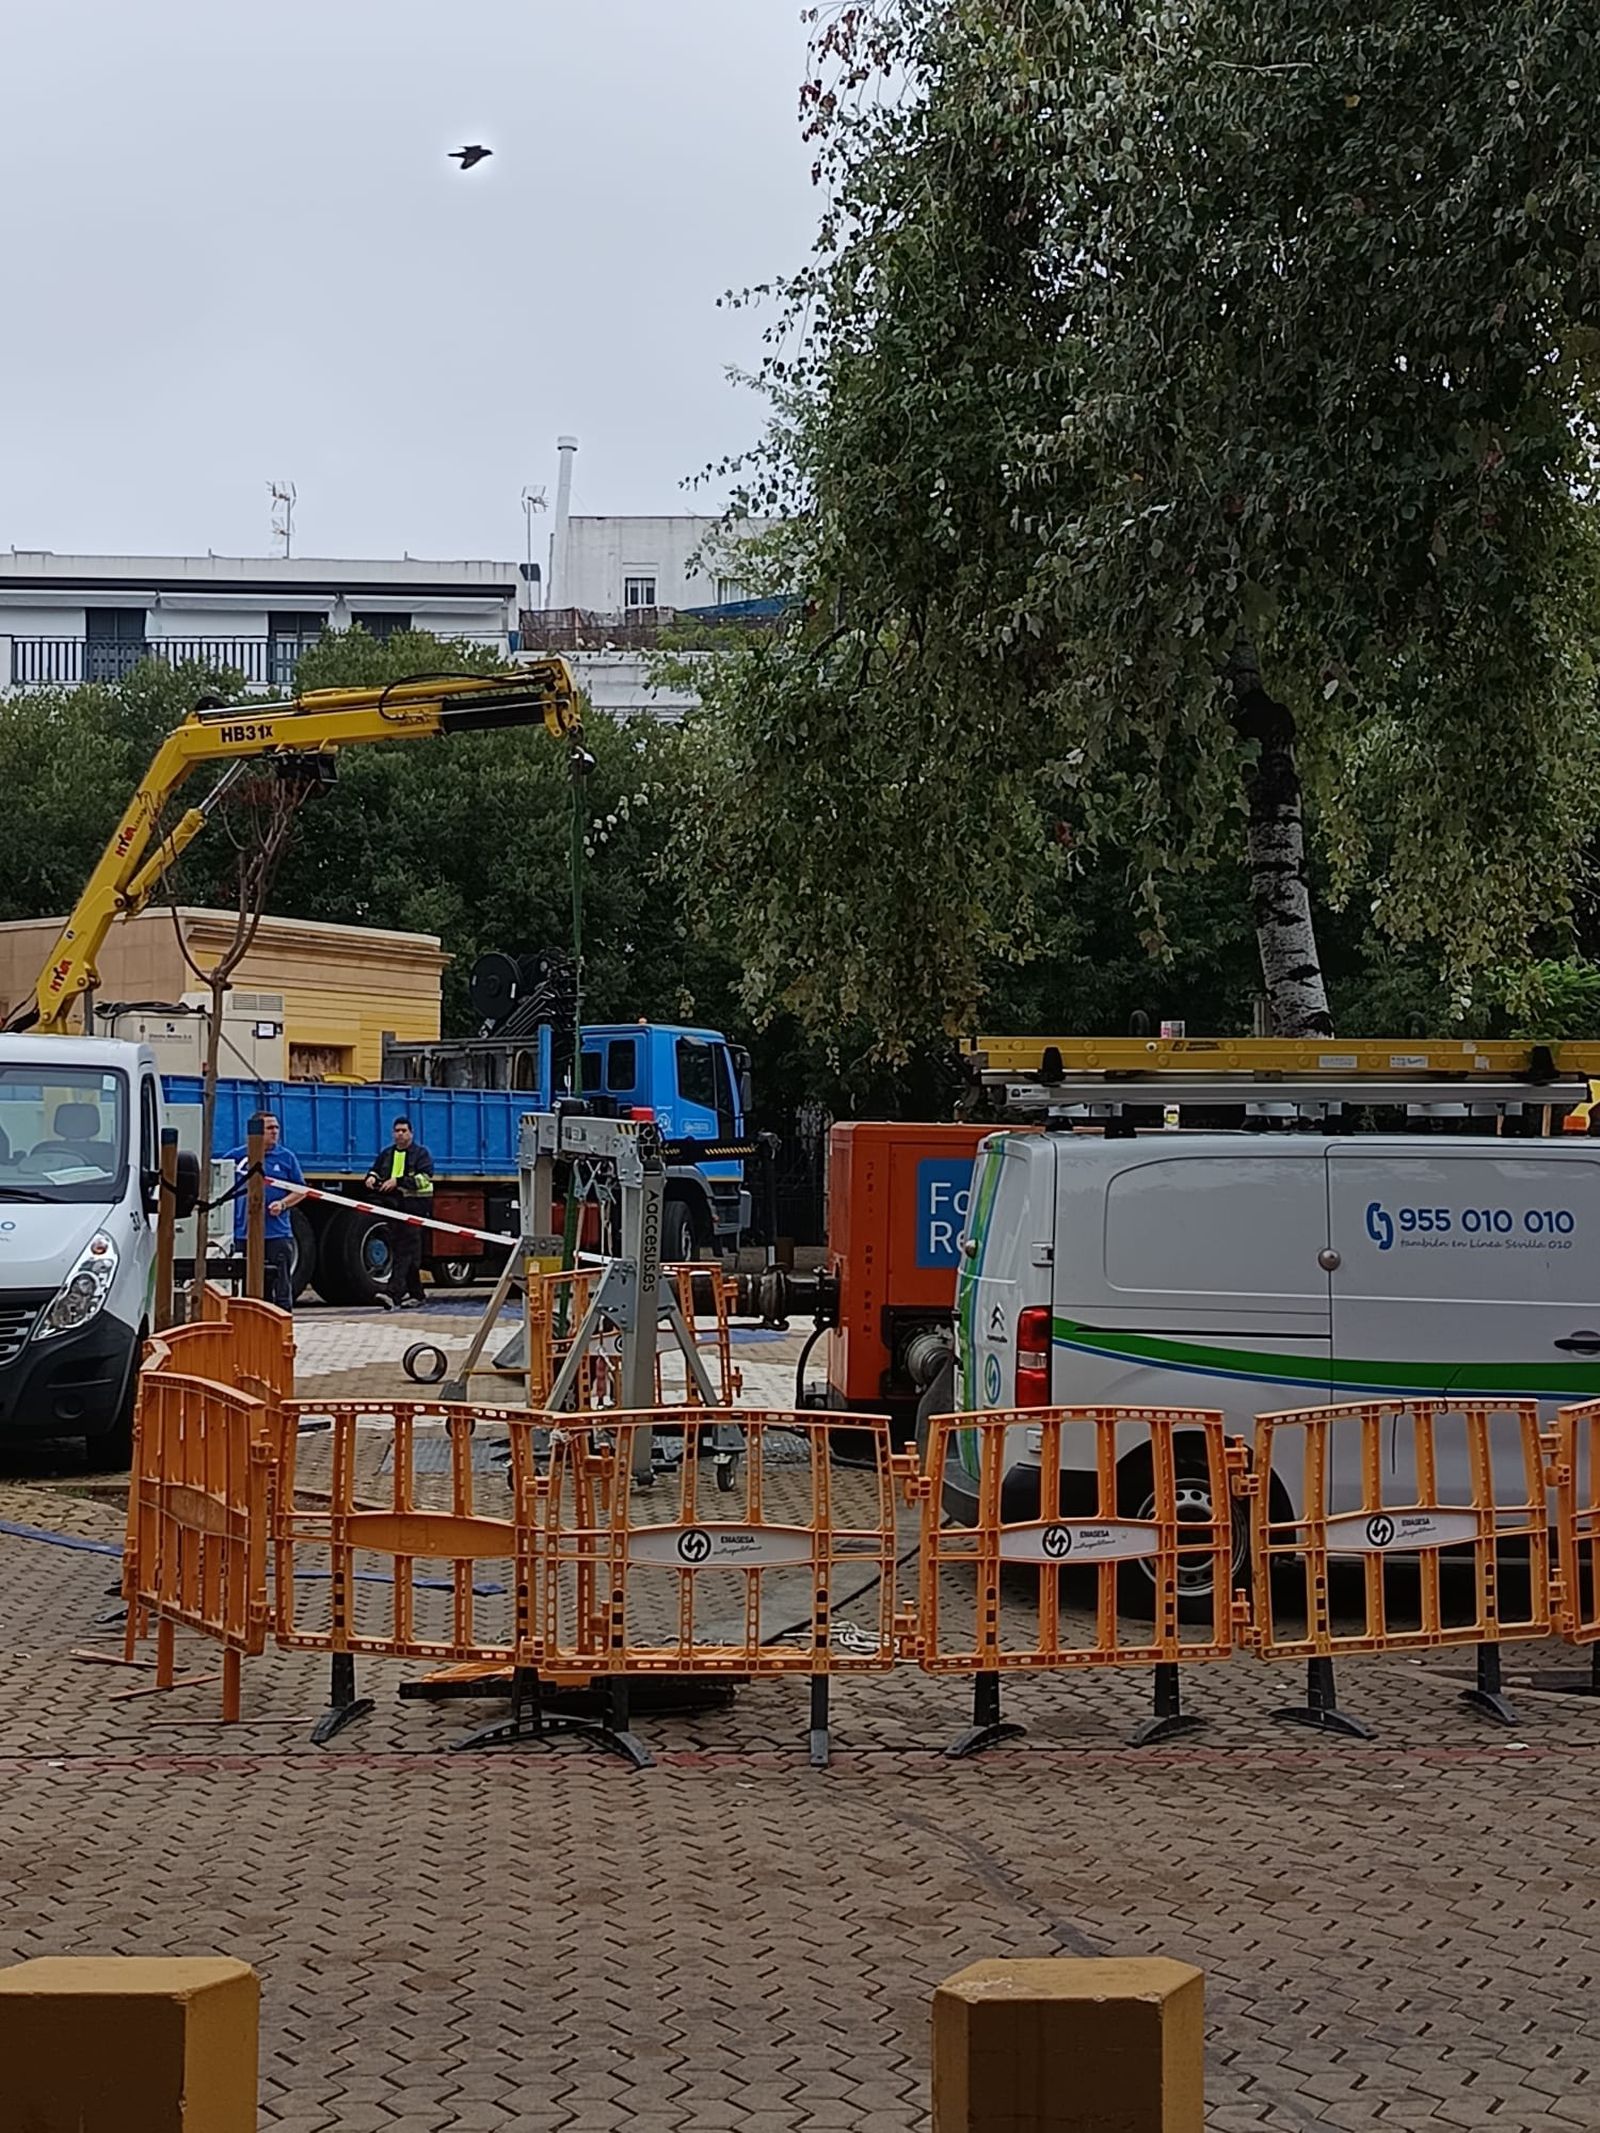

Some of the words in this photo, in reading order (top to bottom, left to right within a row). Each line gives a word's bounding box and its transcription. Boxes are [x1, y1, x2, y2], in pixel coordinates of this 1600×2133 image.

[115, 826, 137, 858] HYVA
[50, 959, 73, 992] HYVA
[1399, 1208, 1451, 1232] 955
[1461, 1209, 1513, 1233] 010
[1524, 1210, 1575, 1234] 010
[1504, 1238, 1547, 1250] Sevilla
[1547, 1239, 1573, 1250] 010
